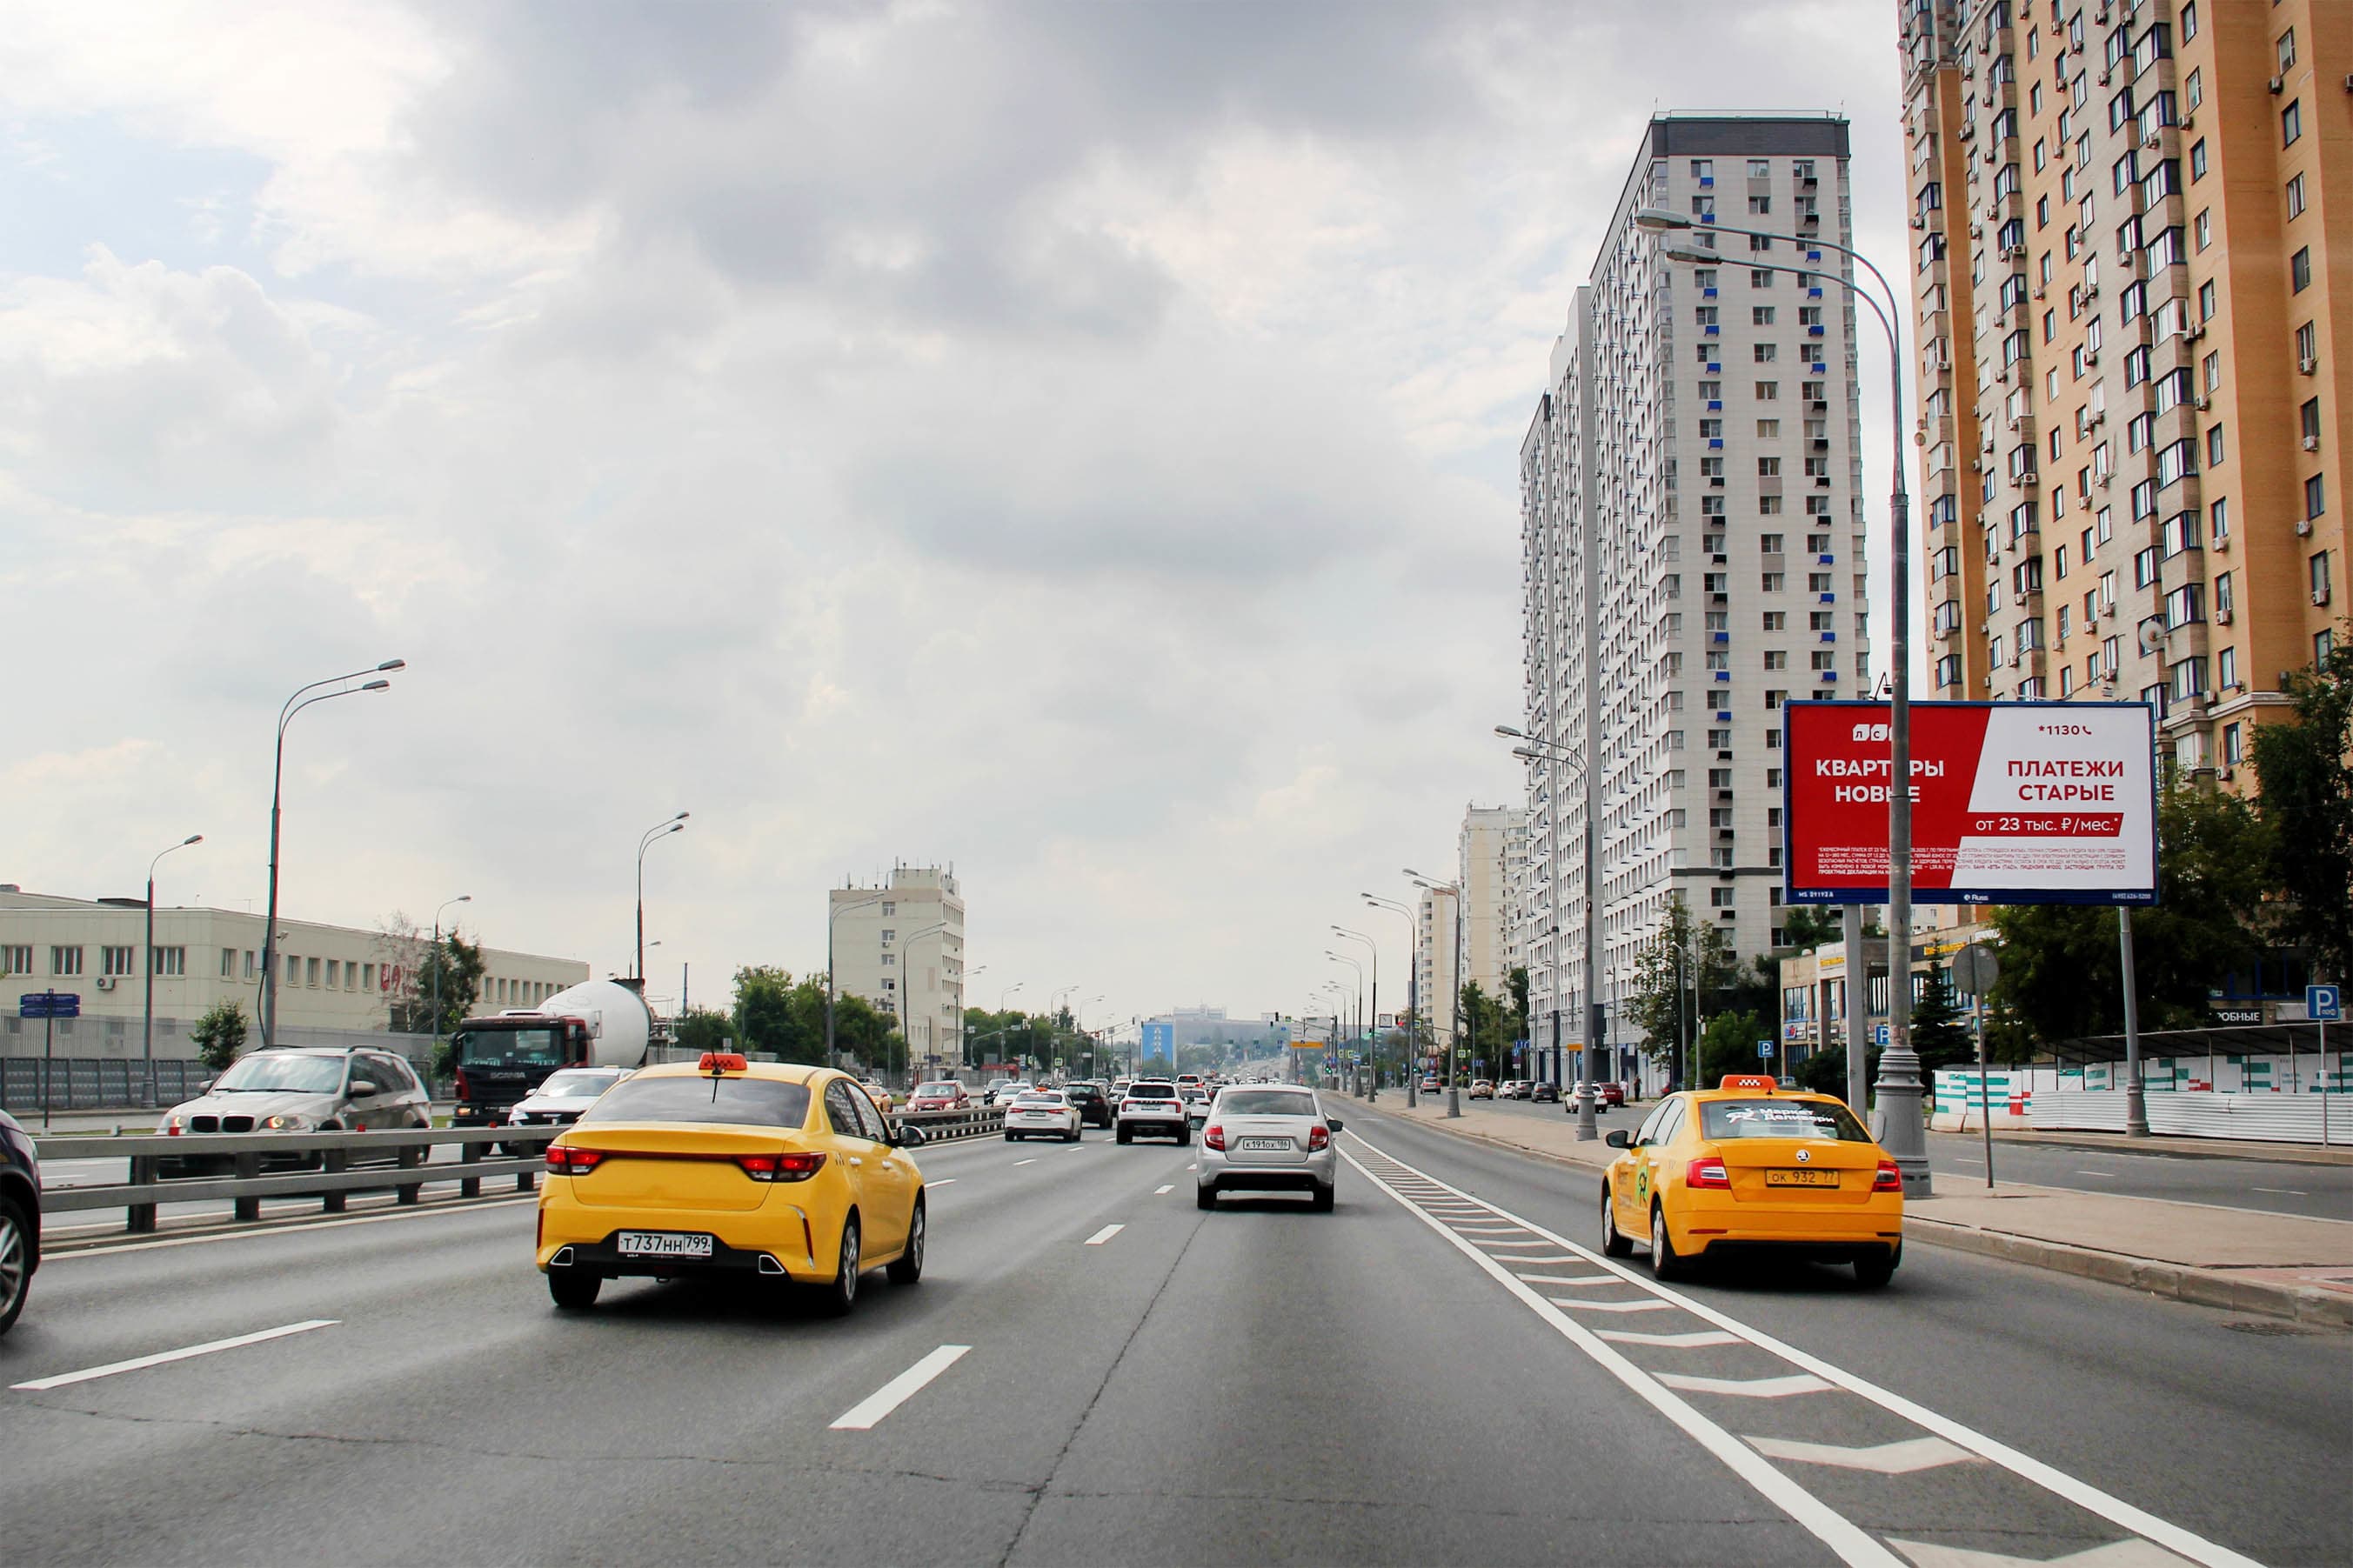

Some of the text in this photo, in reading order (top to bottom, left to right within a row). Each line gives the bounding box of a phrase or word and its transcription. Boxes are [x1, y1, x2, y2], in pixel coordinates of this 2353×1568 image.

[1816, 759, 1944, 777] КВАРТРЫ
[2008, 760, 2123, 777] ПЛАТЕЖИ
[1835, 785, 1921, 803] НОВЕ
[2018, 784, 2115, 801] СТАРЫЕ
[1975, 820, 1995, 831] от
[1999, 817, 2020, 831] 23
[2024, 820, 2057, 831] тыс.
[1793, 1171, 1815, 1183] 932
[686, 1236, 708, 1249] 799
